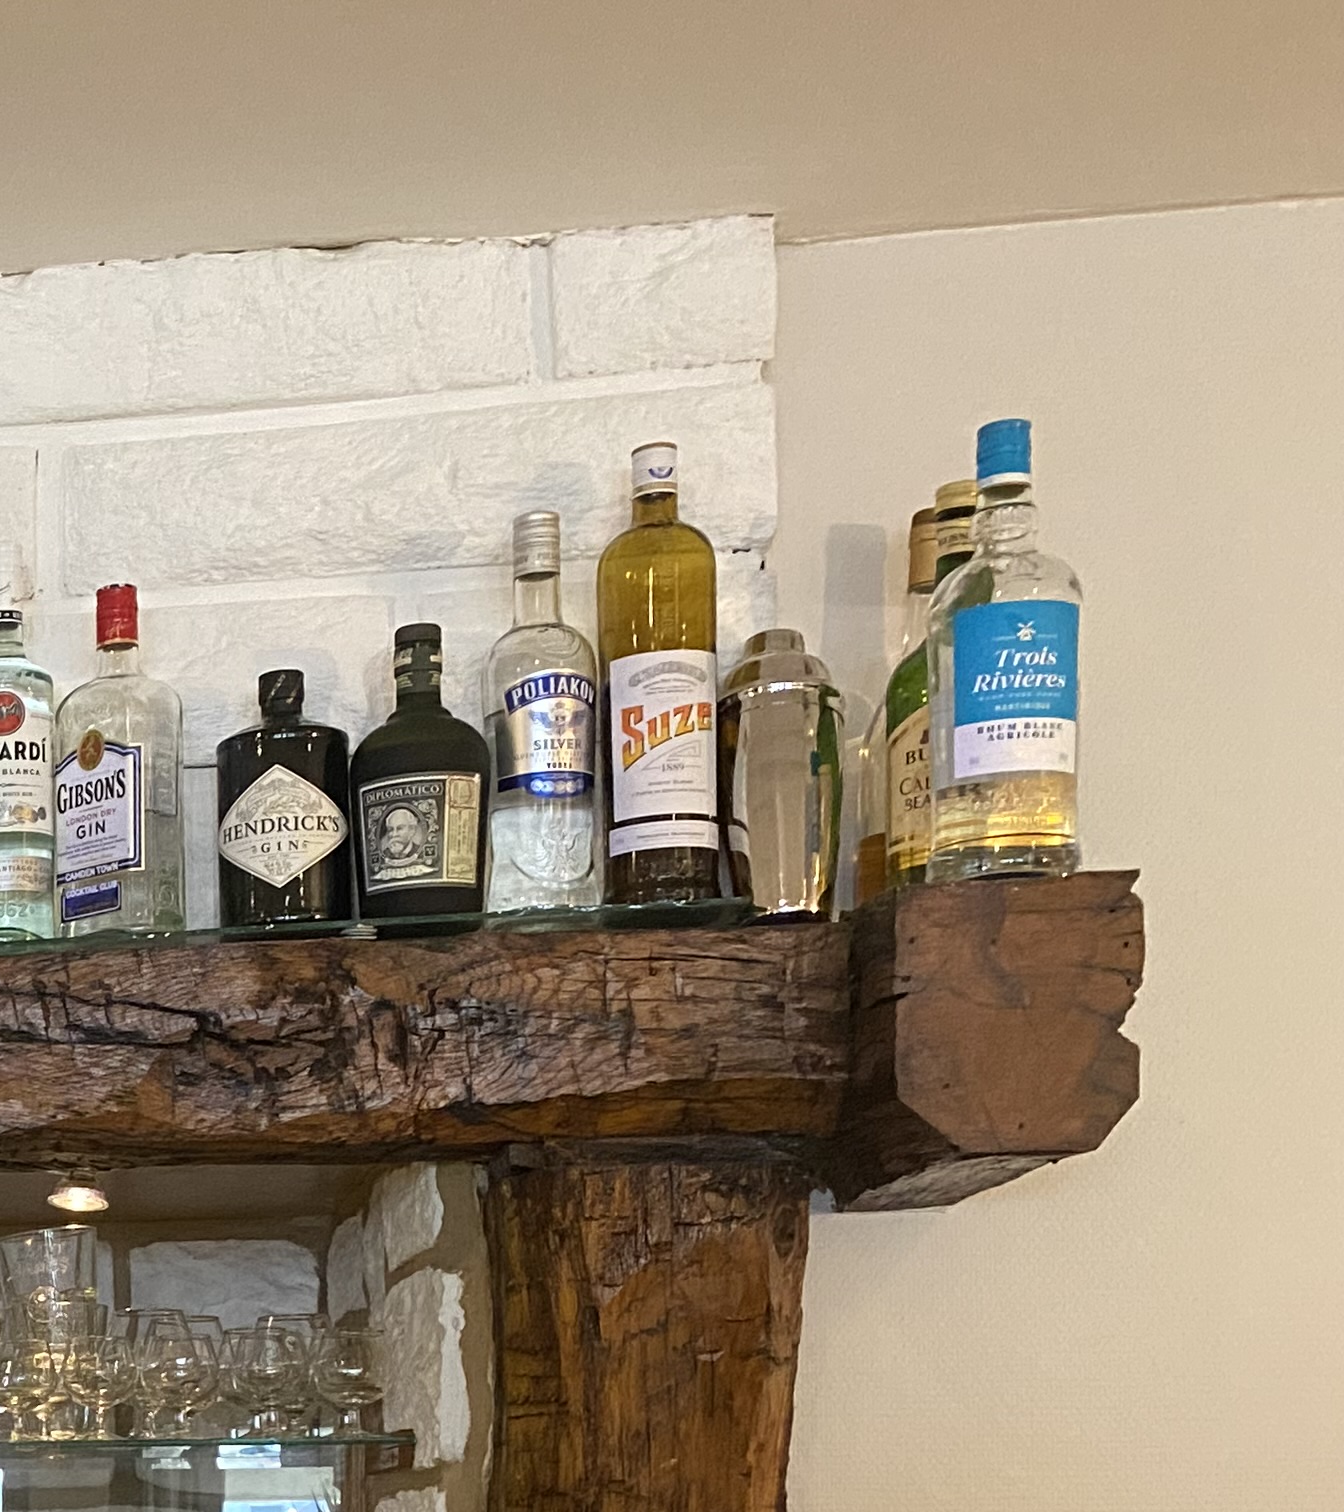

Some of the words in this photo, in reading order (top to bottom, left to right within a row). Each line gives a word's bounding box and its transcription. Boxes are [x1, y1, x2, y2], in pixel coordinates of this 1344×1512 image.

[994, 647, 1057, 669] Trois
[972, 666, 1067, 694] Rivières
[511, 676, 595, 706] POLIAKOV
[533, 738, 582, 751] SILVER
[621, 701, 712, 773] Suze
[2, 767, 42, 777] BLANCA
[57, 768, 126, 815] GIBSON'S
[65, 812, 99, 828] LONDON
[100, 807, 117, 820] DRY
[76, 820, 107, 840] GIN
[223, 814, 340, 845] HENDRICK'S
[260, 840, 300, 854] GIN
[64, 867, 96, 882] CAMDEN
[96, 862, 120, 875] TOWN
